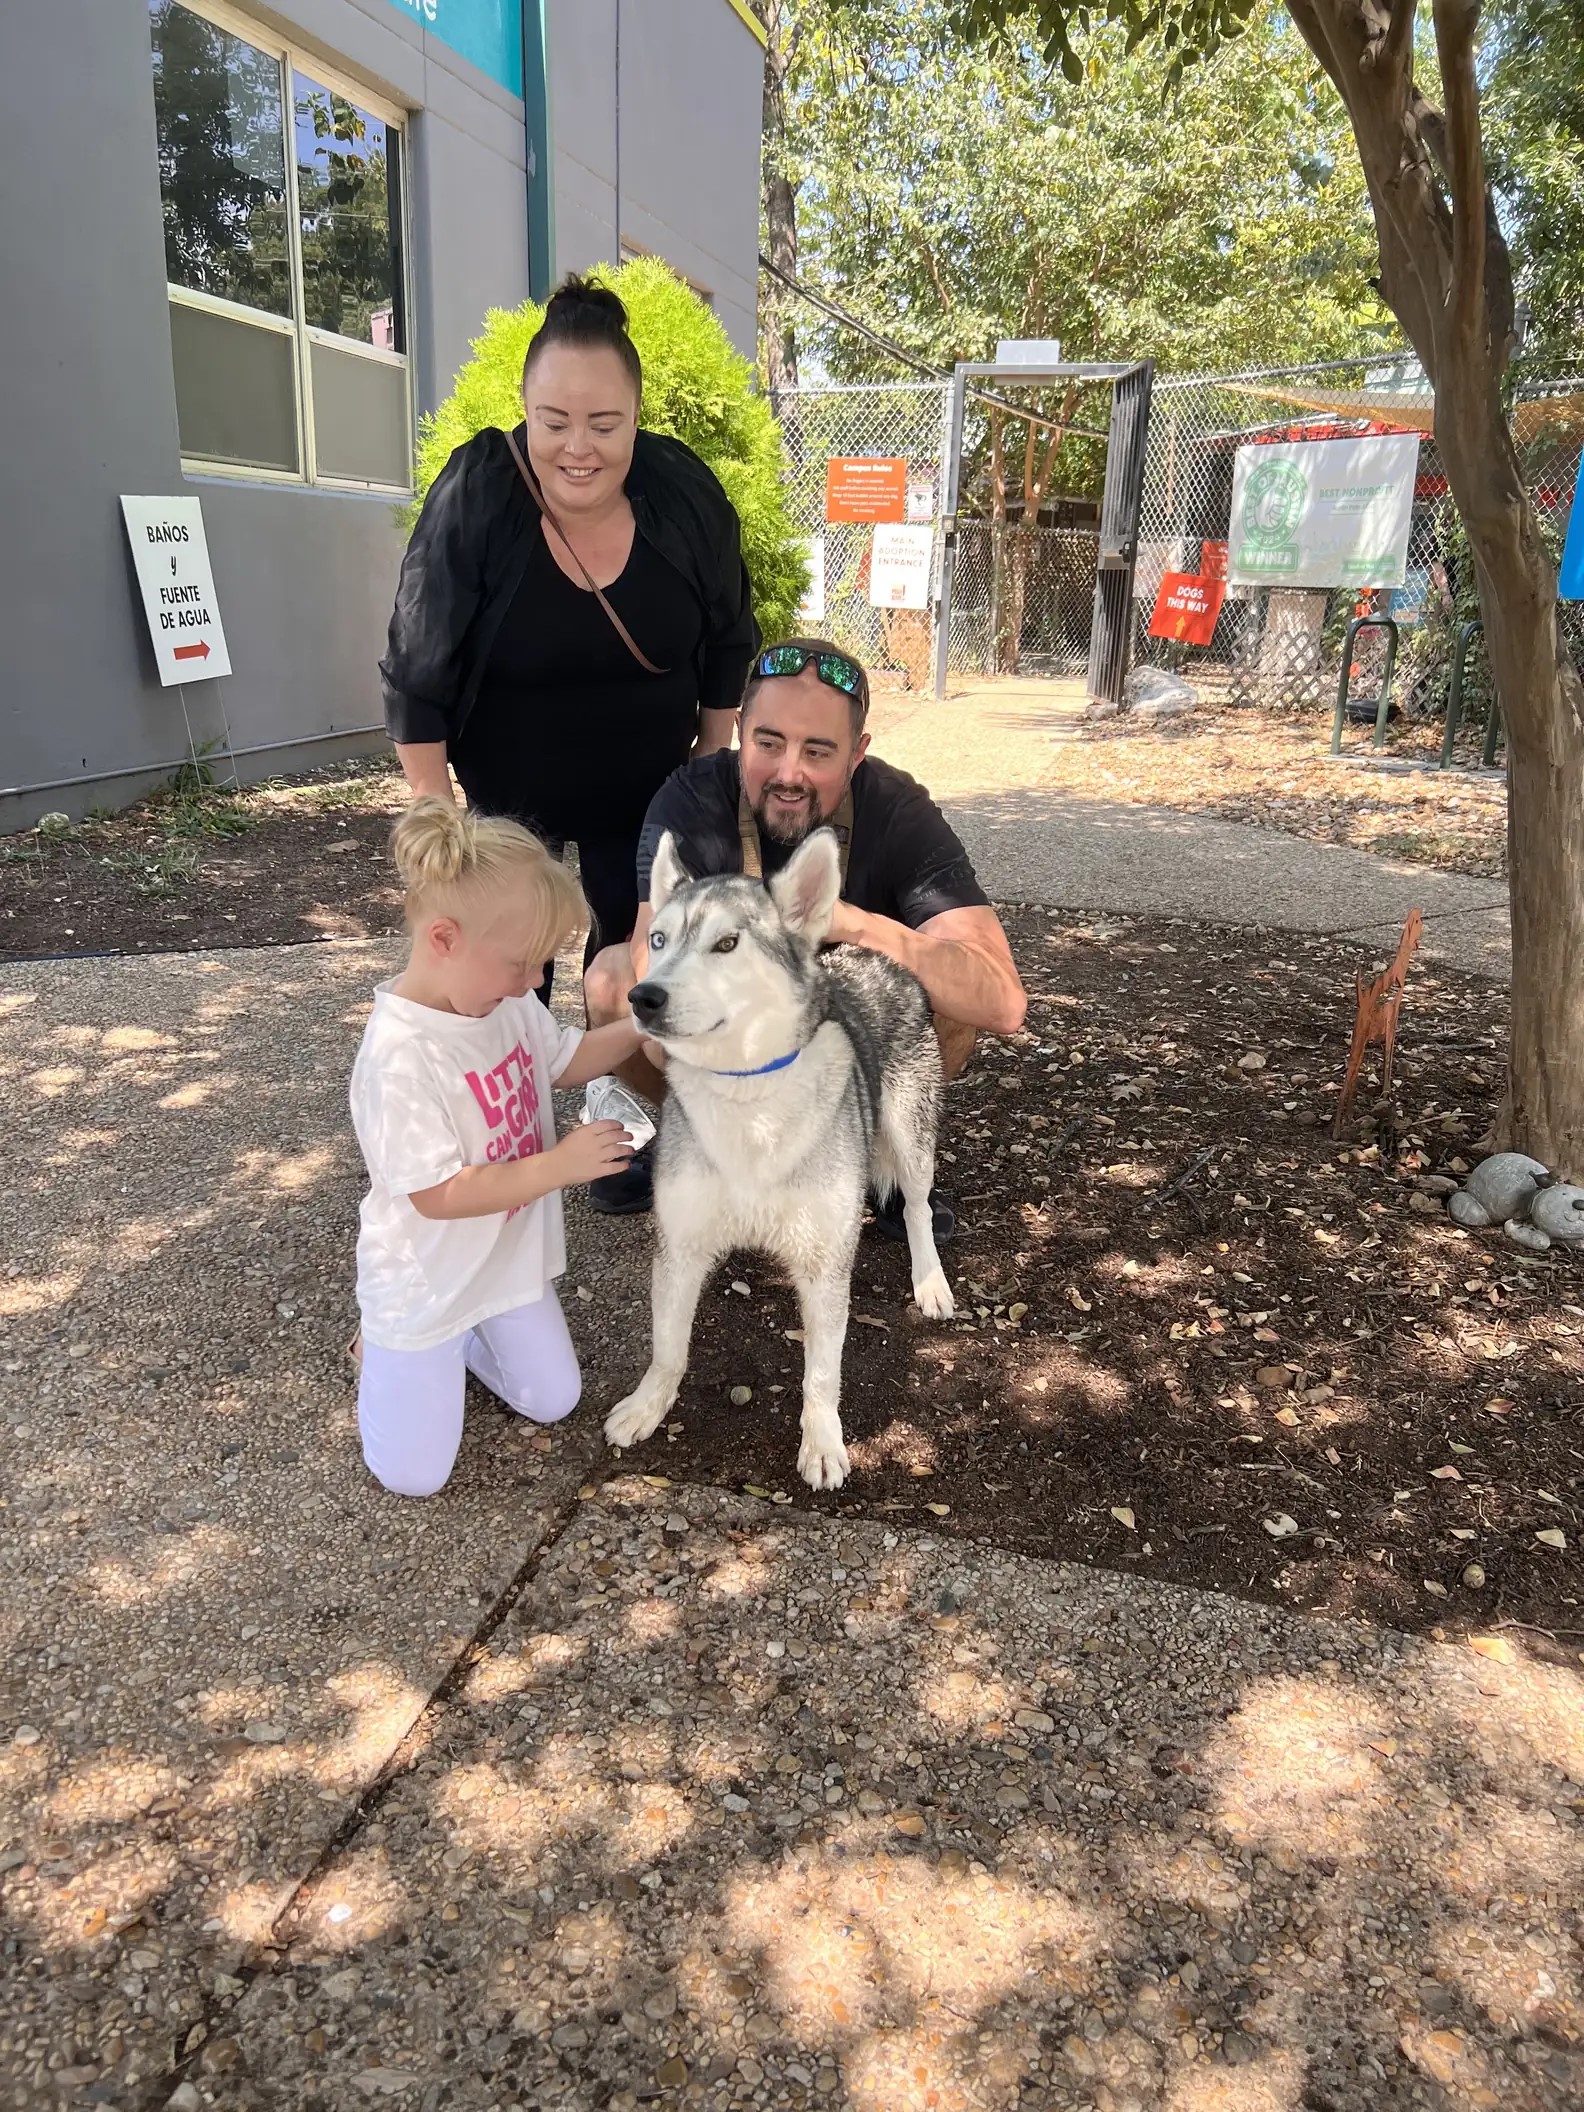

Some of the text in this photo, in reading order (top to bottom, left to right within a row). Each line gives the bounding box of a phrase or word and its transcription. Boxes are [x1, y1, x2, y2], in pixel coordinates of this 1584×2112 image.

[843, 463, 893, 474] Campus Rules
[1319, 488, 1339, 498] BEST
[1246, 472, 1301, 529] BEST OF AUSTIN
[146, 521, 189, 543] BAÑOS
[891, 537, 915, 545] MAIN
[878, 547, 925, 557] ADOPTION
[1244, 551, 1293, 565] WINNER
[878, 558, 923, 568] ENTRANCE
[160, 585, 201, 605] FUENTE
[1177, 585, 1204, 599] DOGS
[1166, 597, 1209, 613] THIS WAY
[160, 608, 211, 630] DE AGUA
[486, 1129, 512, 1162] CAN
